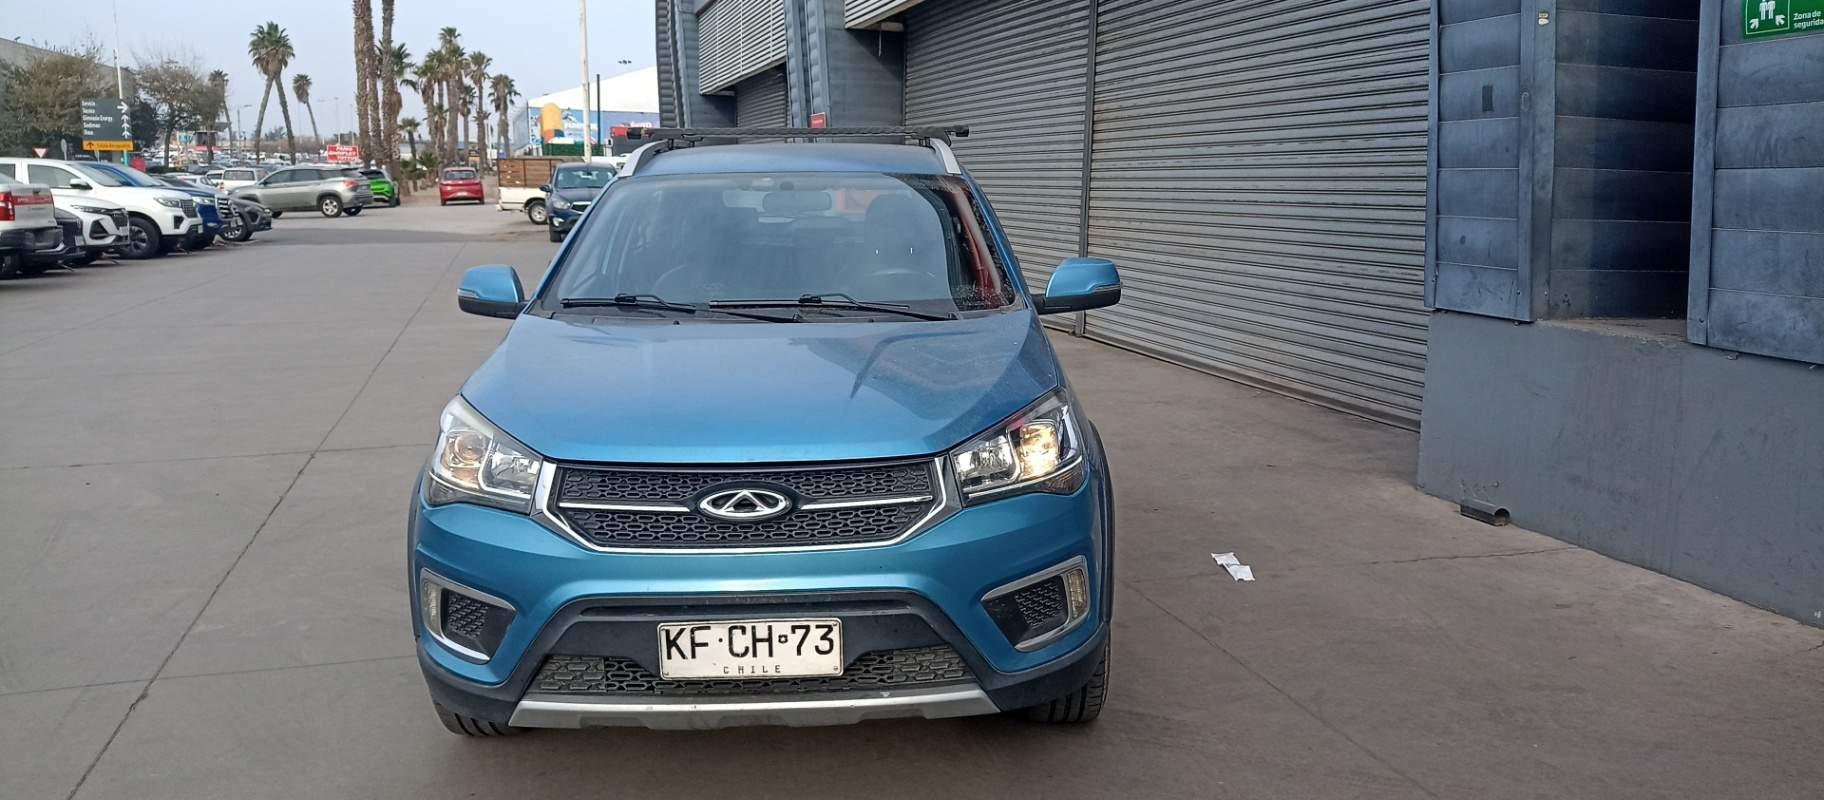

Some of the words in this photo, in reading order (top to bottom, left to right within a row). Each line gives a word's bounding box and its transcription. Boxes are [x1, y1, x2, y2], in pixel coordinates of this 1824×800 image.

[1793, 12, 1811, 20] Zona
[1812, 10, 1821, 18] de
[723, 664, 781, 674] CHILE
